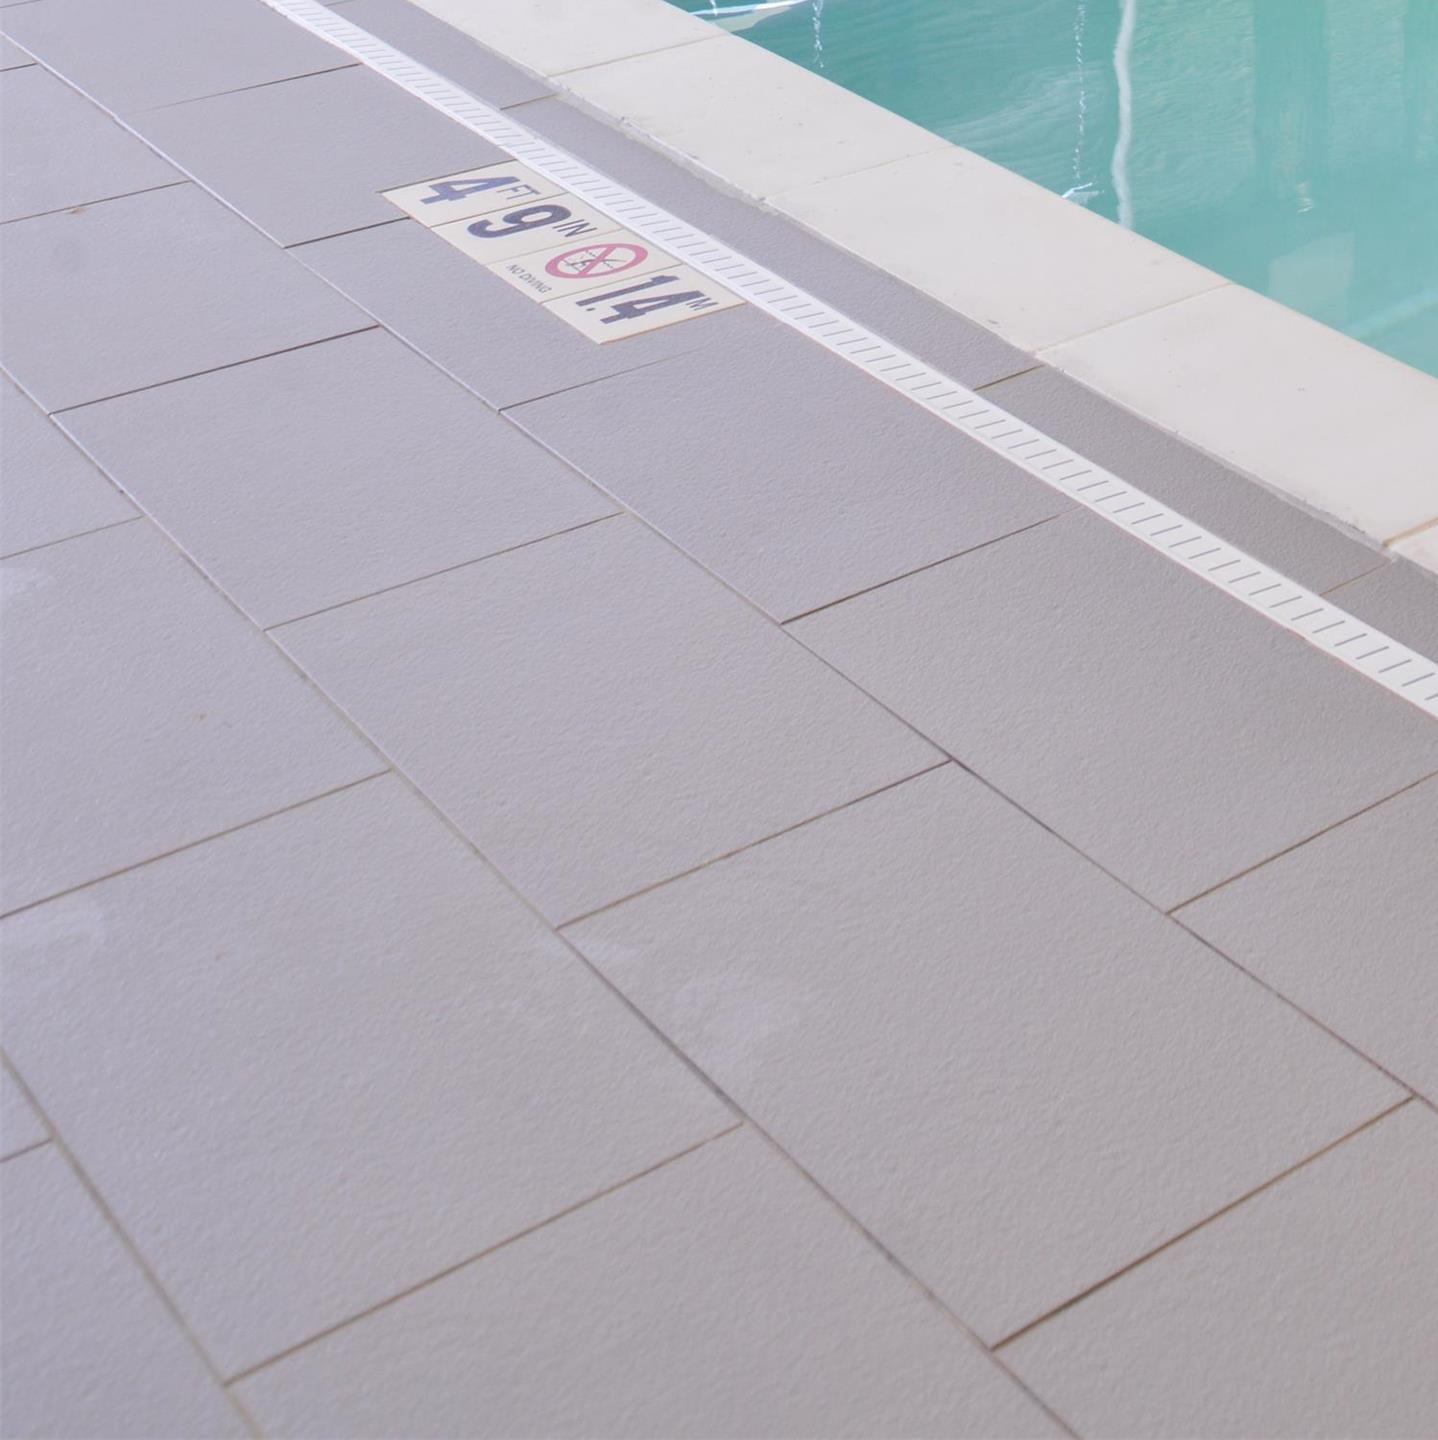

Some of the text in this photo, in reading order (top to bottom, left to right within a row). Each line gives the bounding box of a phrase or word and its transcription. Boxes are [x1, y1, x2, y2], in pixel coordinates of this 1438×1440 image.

[420, 176, 521, 205] 4
[496, 184, 541, 200] FT
[467, 204, 572, 239] 9
[552, 219, 598, 238] IN
